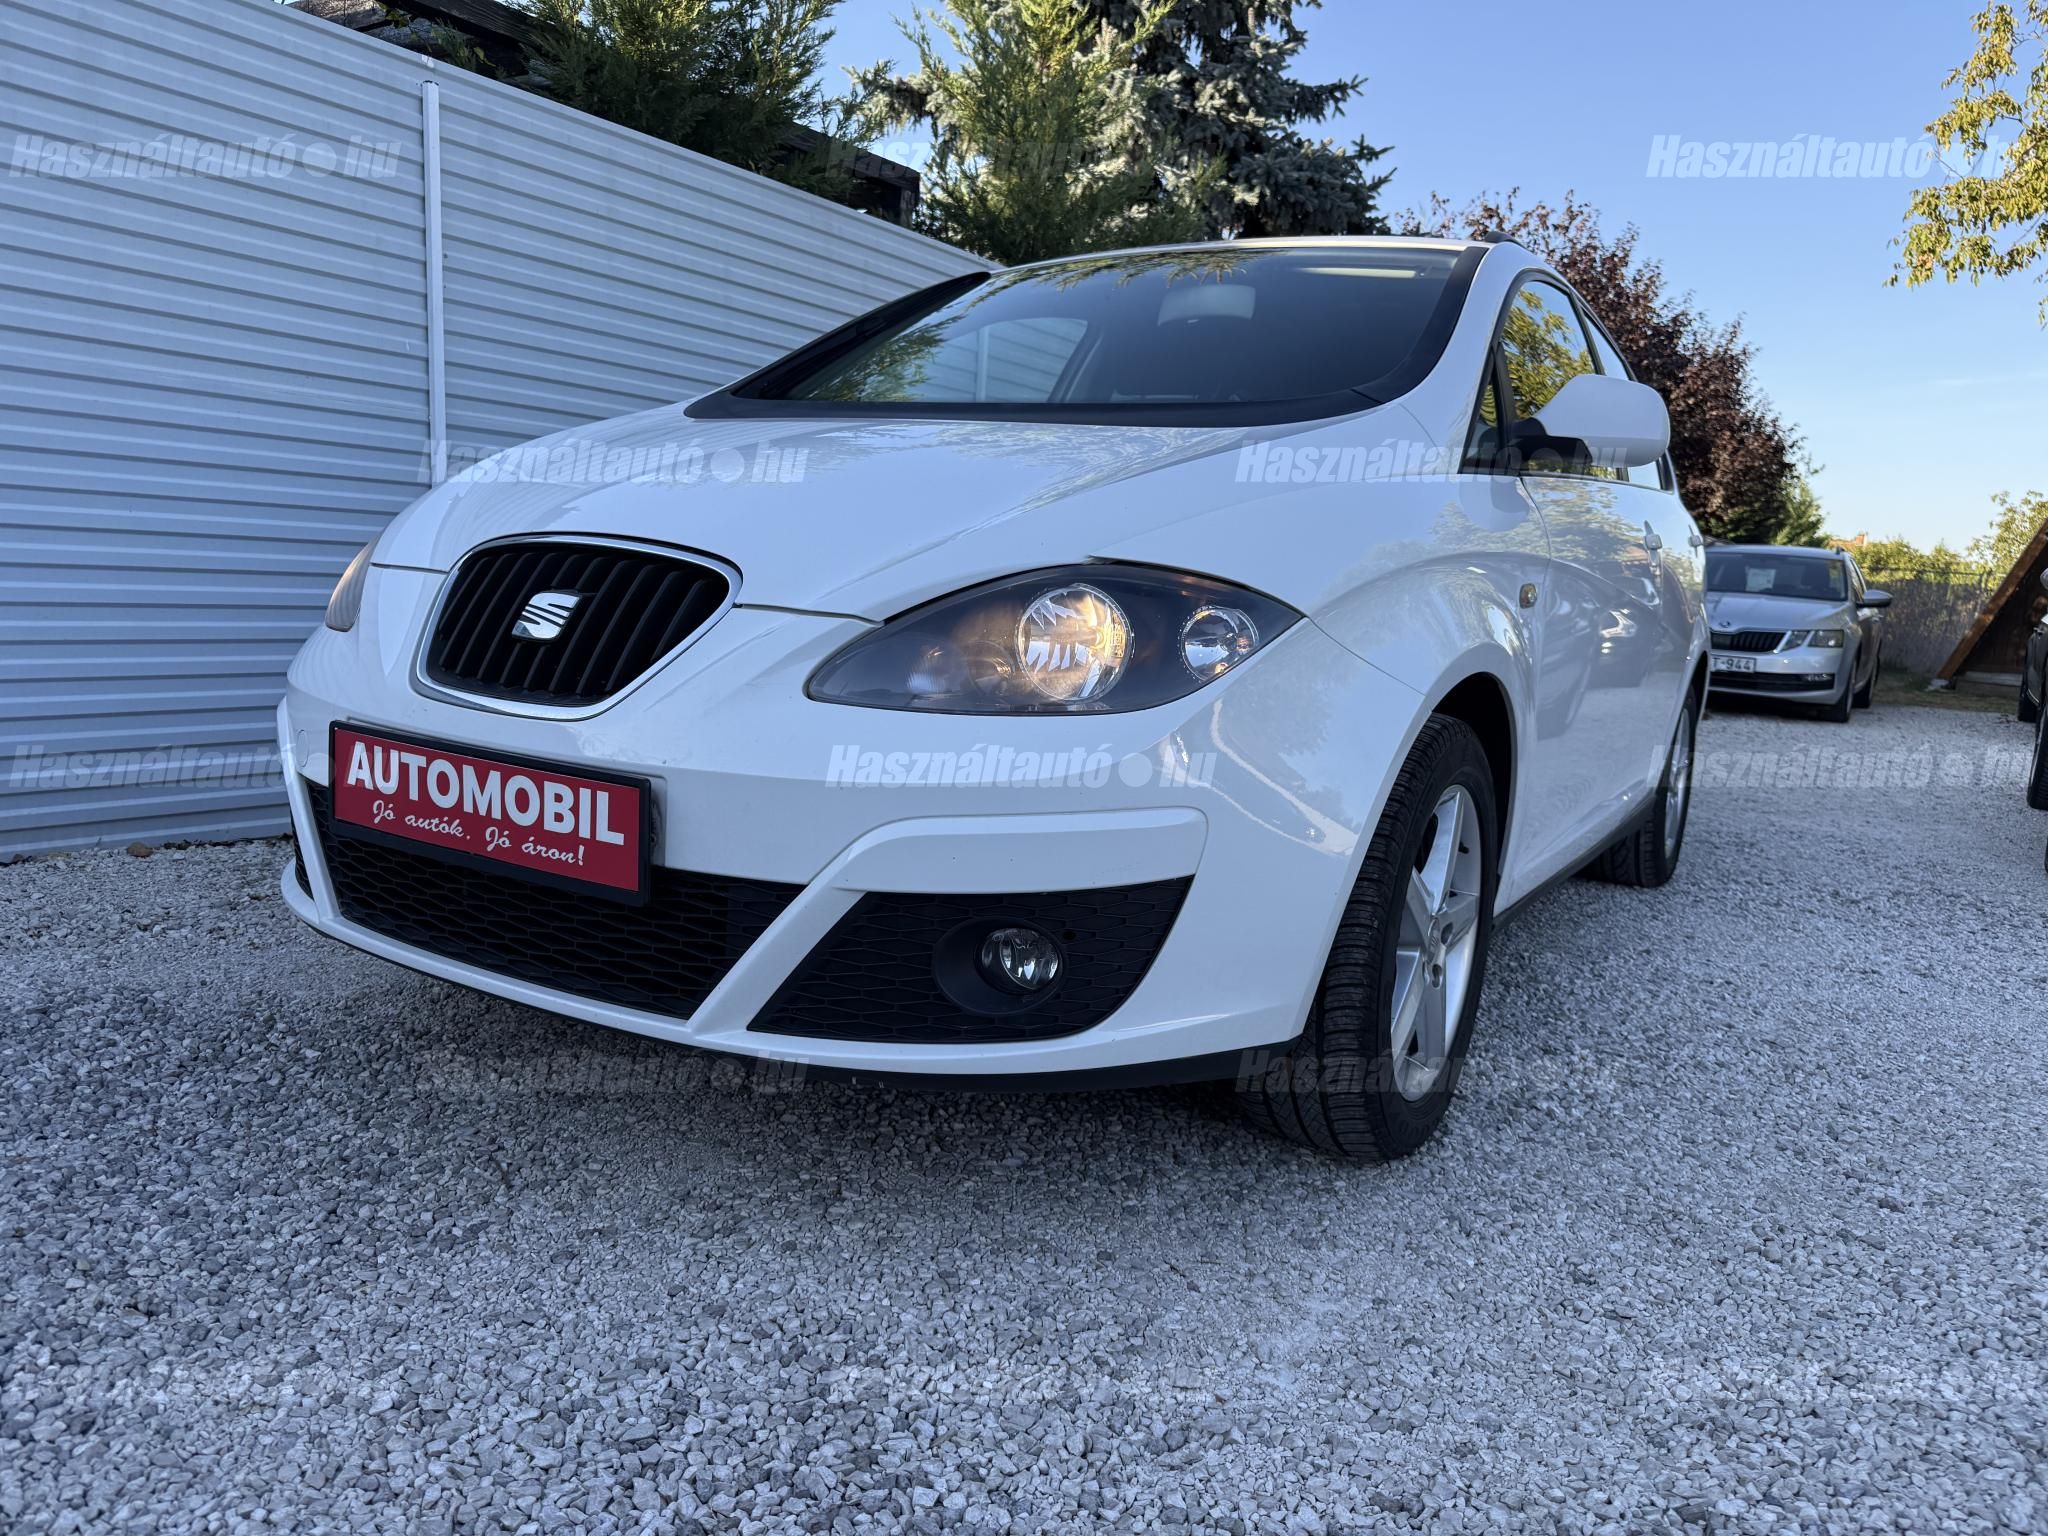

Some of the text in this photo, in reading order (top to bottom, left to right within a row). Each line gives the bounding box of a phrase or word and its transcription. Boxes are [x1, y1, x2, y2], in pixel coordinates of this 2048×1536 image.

[347, 741, 625, 846] AUTOMOBIL
[373, 799, 585, 866] Jó autók. Jó áron!
